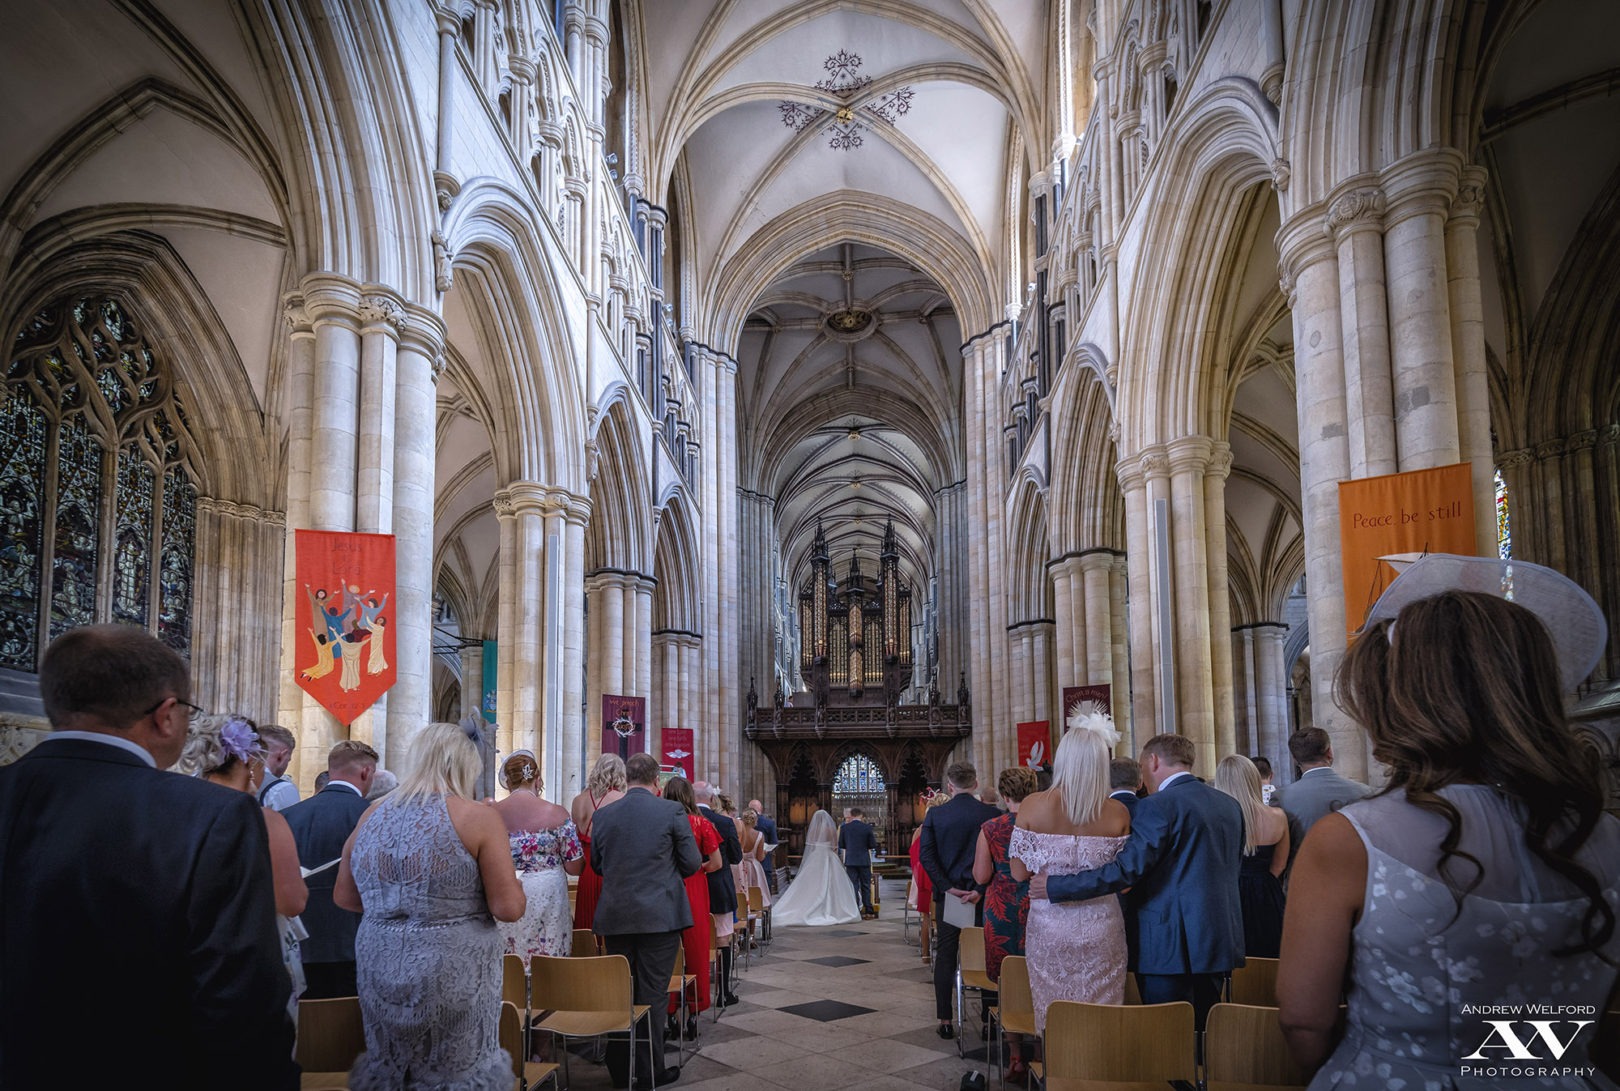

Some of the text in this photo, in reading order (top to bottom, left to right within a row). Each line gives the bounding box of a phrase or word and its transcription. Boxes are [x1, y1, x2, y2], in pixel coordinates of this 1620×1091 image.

[1353, 500, 1461, 529] Peace be still
[331, 537, 362, 552] Jesus
